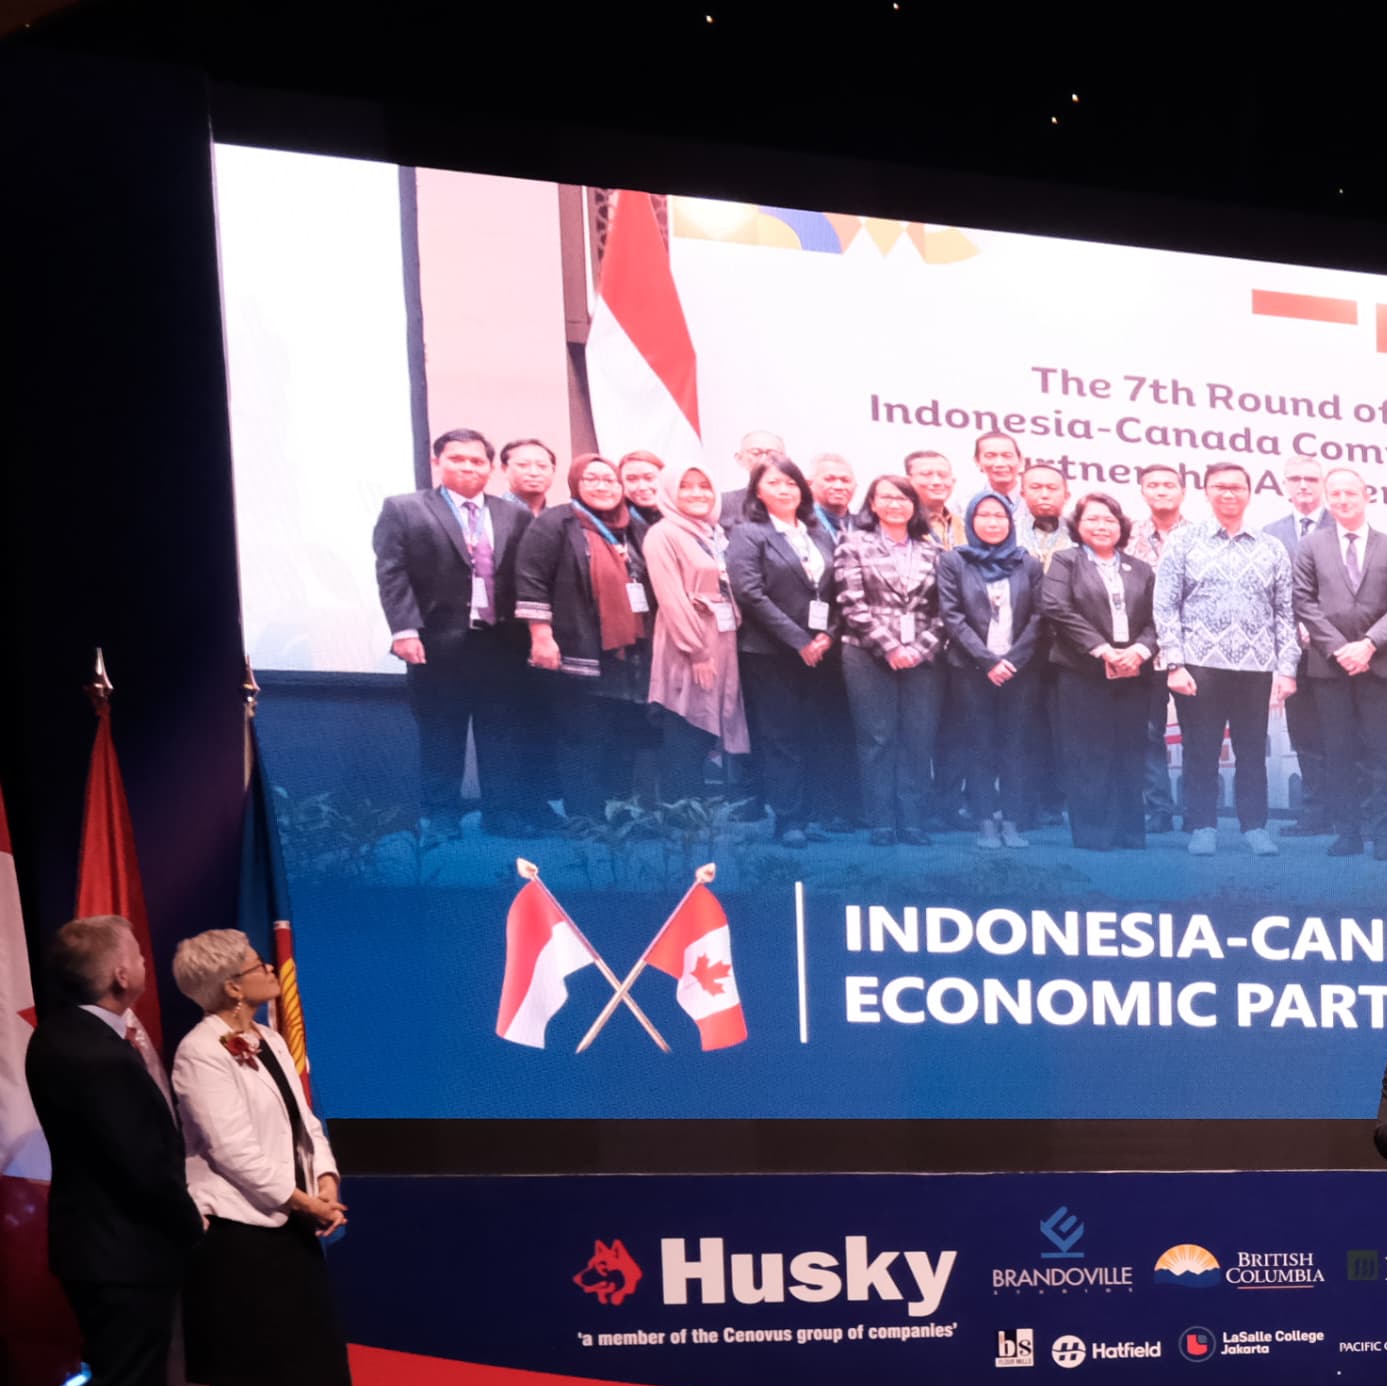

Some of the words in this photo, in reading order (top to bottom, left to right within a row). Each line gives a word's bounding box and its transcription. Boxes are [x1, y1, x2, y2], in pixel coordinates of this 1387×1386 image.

[1031, 366, 1112, 399] The
[1123, 375, 1197, 408] 7th
[1206, 383, 1343, 421] Round
[870, 394, 1281, 456] Indonesia-Canada
[845, 975, 1217, 1027] ECONOMIC
[1238, 1252, 1314, 1268] BRITISH
[661, 1235, 959, 1318] Husky
[992, 1267, 1134, 1287] BRANDOVILLE
[1225, 1268, 1326, 1285] COLUMBIA
[598, 1329, 665, 1347] member
[670, 1328, 688, 1345] of
[692, 1328, 719, 1344] the
[723, 1326, 793, 1343] Cenovus
[797, 1327, 843, 1345] group
[848, 1324, 865, 1340] of
[1223, 1332, 1272, 1344] LaSalle
[1275, 1330, 1325, 1343] College
[1092, 1341, 1162, 1360] Hatfield
[1221, 1344, 1270, 1355] Jakarta
[1339, 1341, 1382, 1352] PACIFIC
